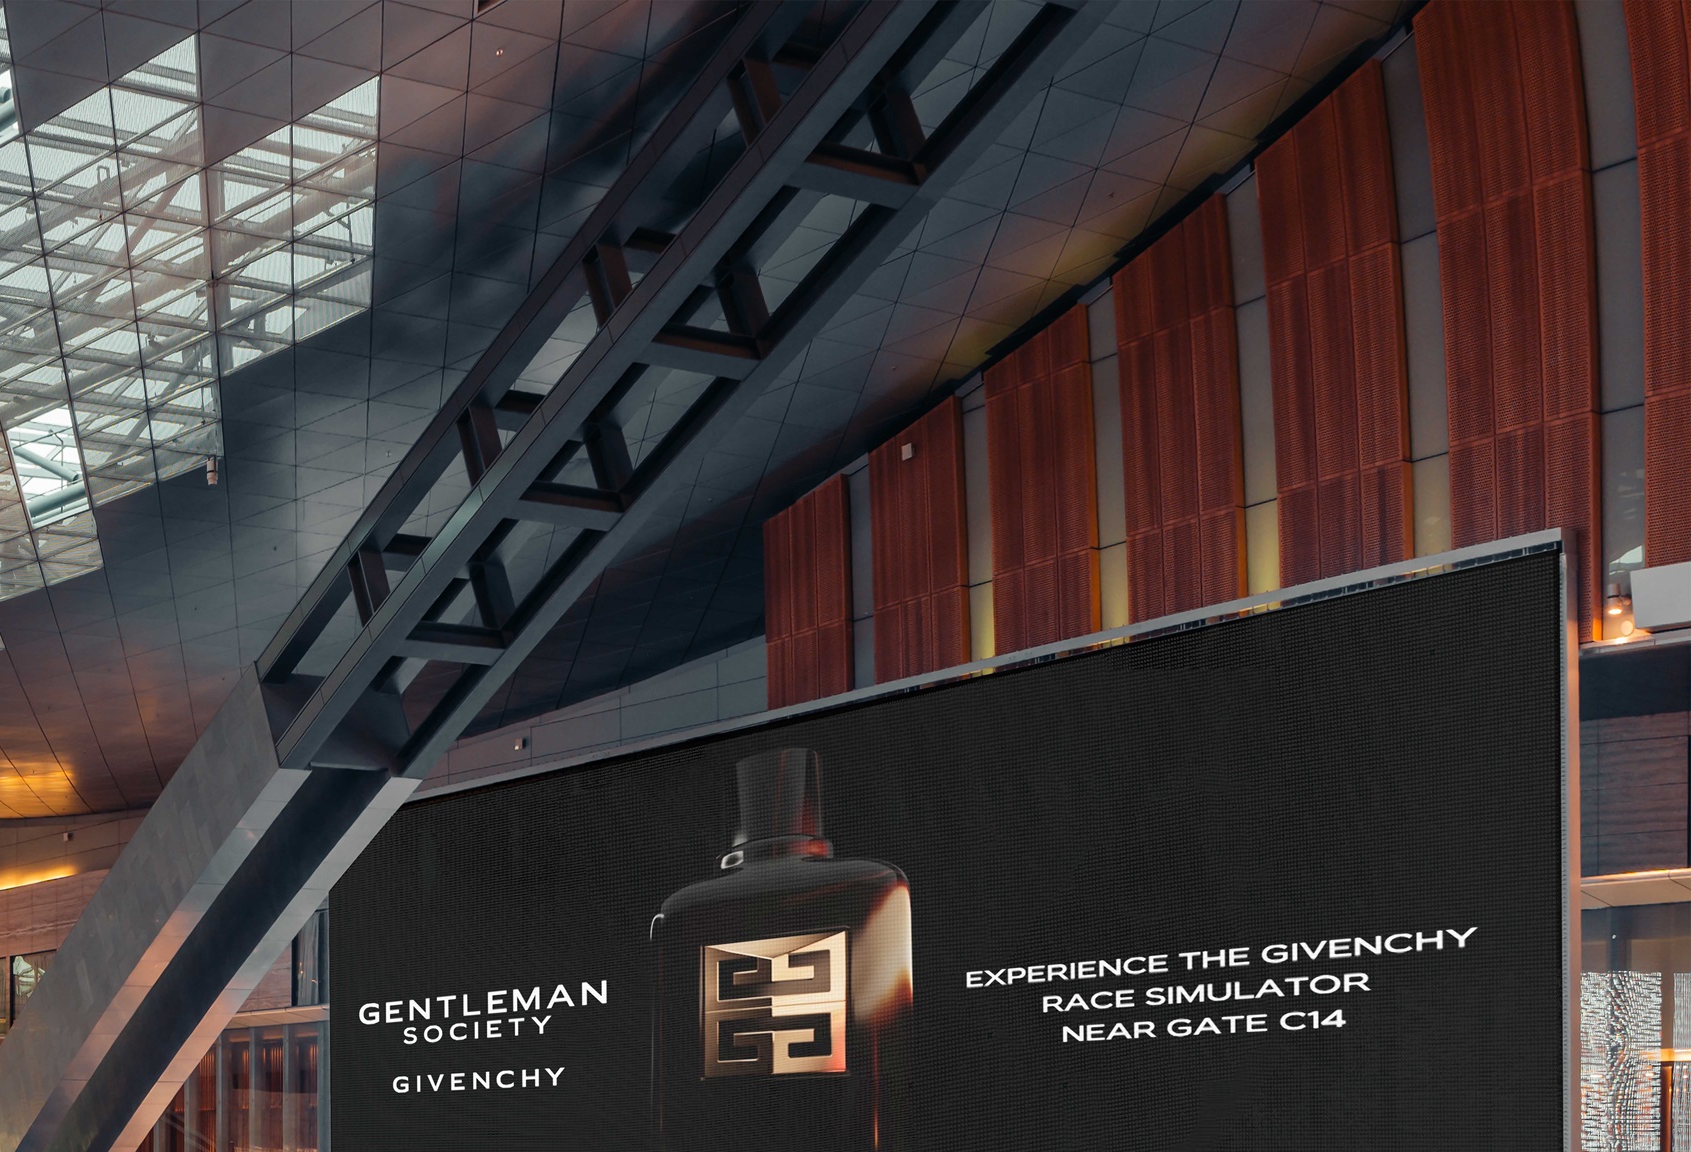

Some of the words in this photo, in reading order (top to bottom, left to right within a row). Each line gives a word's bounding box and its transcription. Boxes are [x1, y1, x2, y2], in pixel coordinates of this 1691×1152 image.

[967, 955, 1168, 987] EXPERIENCE
[1179, 948, 1249, 969] THE
[1262, 927, 1477, 963] GIVENCHY
[359, 980, 607, 1024] GENTLEMAN
[1043, 990, 1134, 1012] RACE
[1146, 973, 1370, 1005] SIMULATOR
[404, 1016, 551, 1044] SOCIETY
[1063, 1018, 1156, 1042] NEAR
[1167, 1014, 1267, 1036] GATE
[1280, 1010, 1346, 1030] C14
[393, 1068, 564, 1093] GIVENCHY
